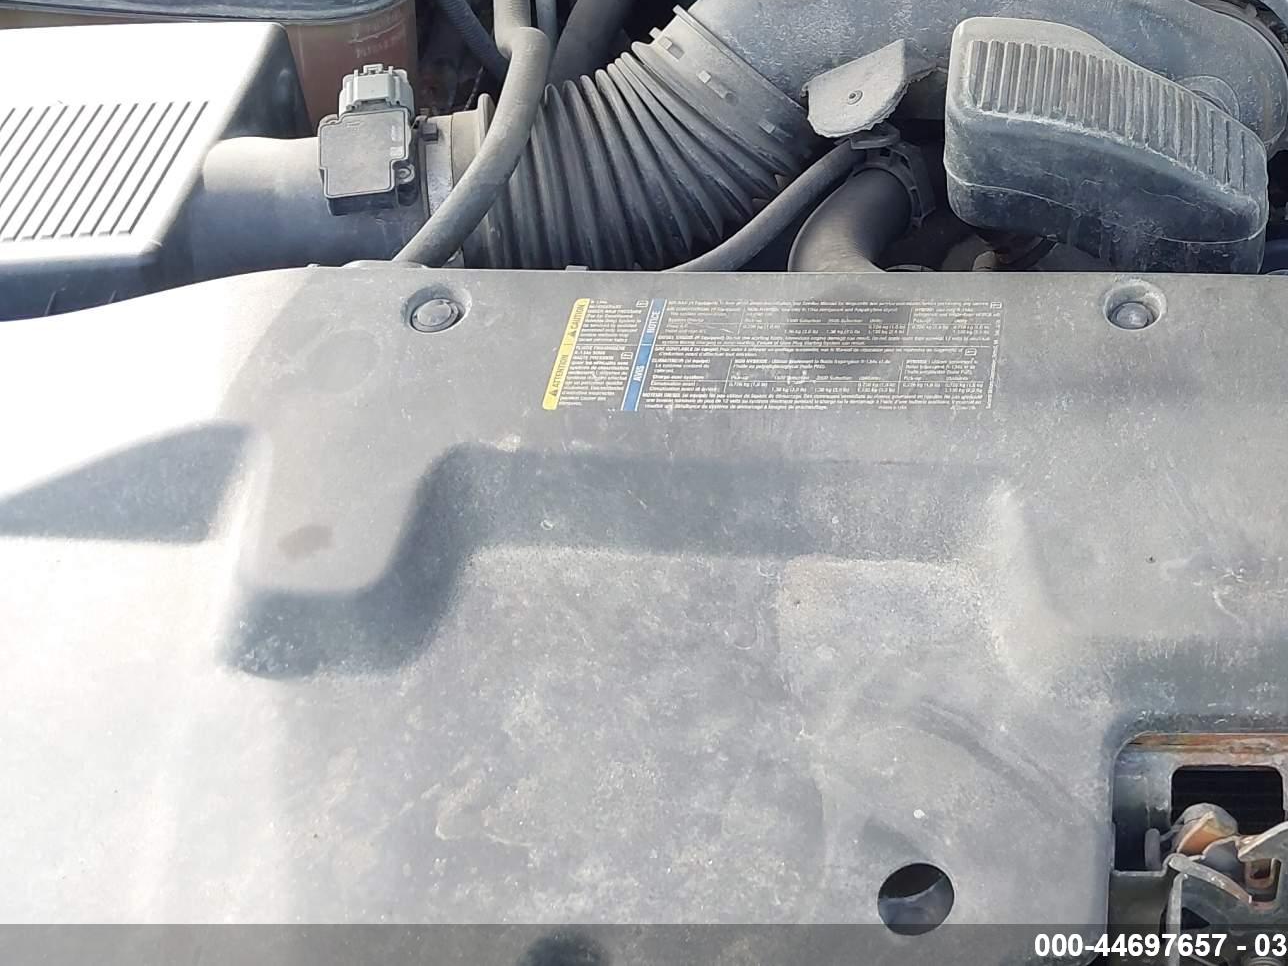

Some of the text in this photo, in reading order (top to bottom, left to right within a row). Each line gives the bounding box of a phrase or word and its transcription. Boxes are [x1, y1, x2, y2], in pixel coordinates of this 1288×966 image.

[570, 304, 586, 330] CAUTION
[646, 310, 659, 334] NOTICE
[552, 354, 569, 388] ATTENTION
[632, 364, 645, 382] AVIS
